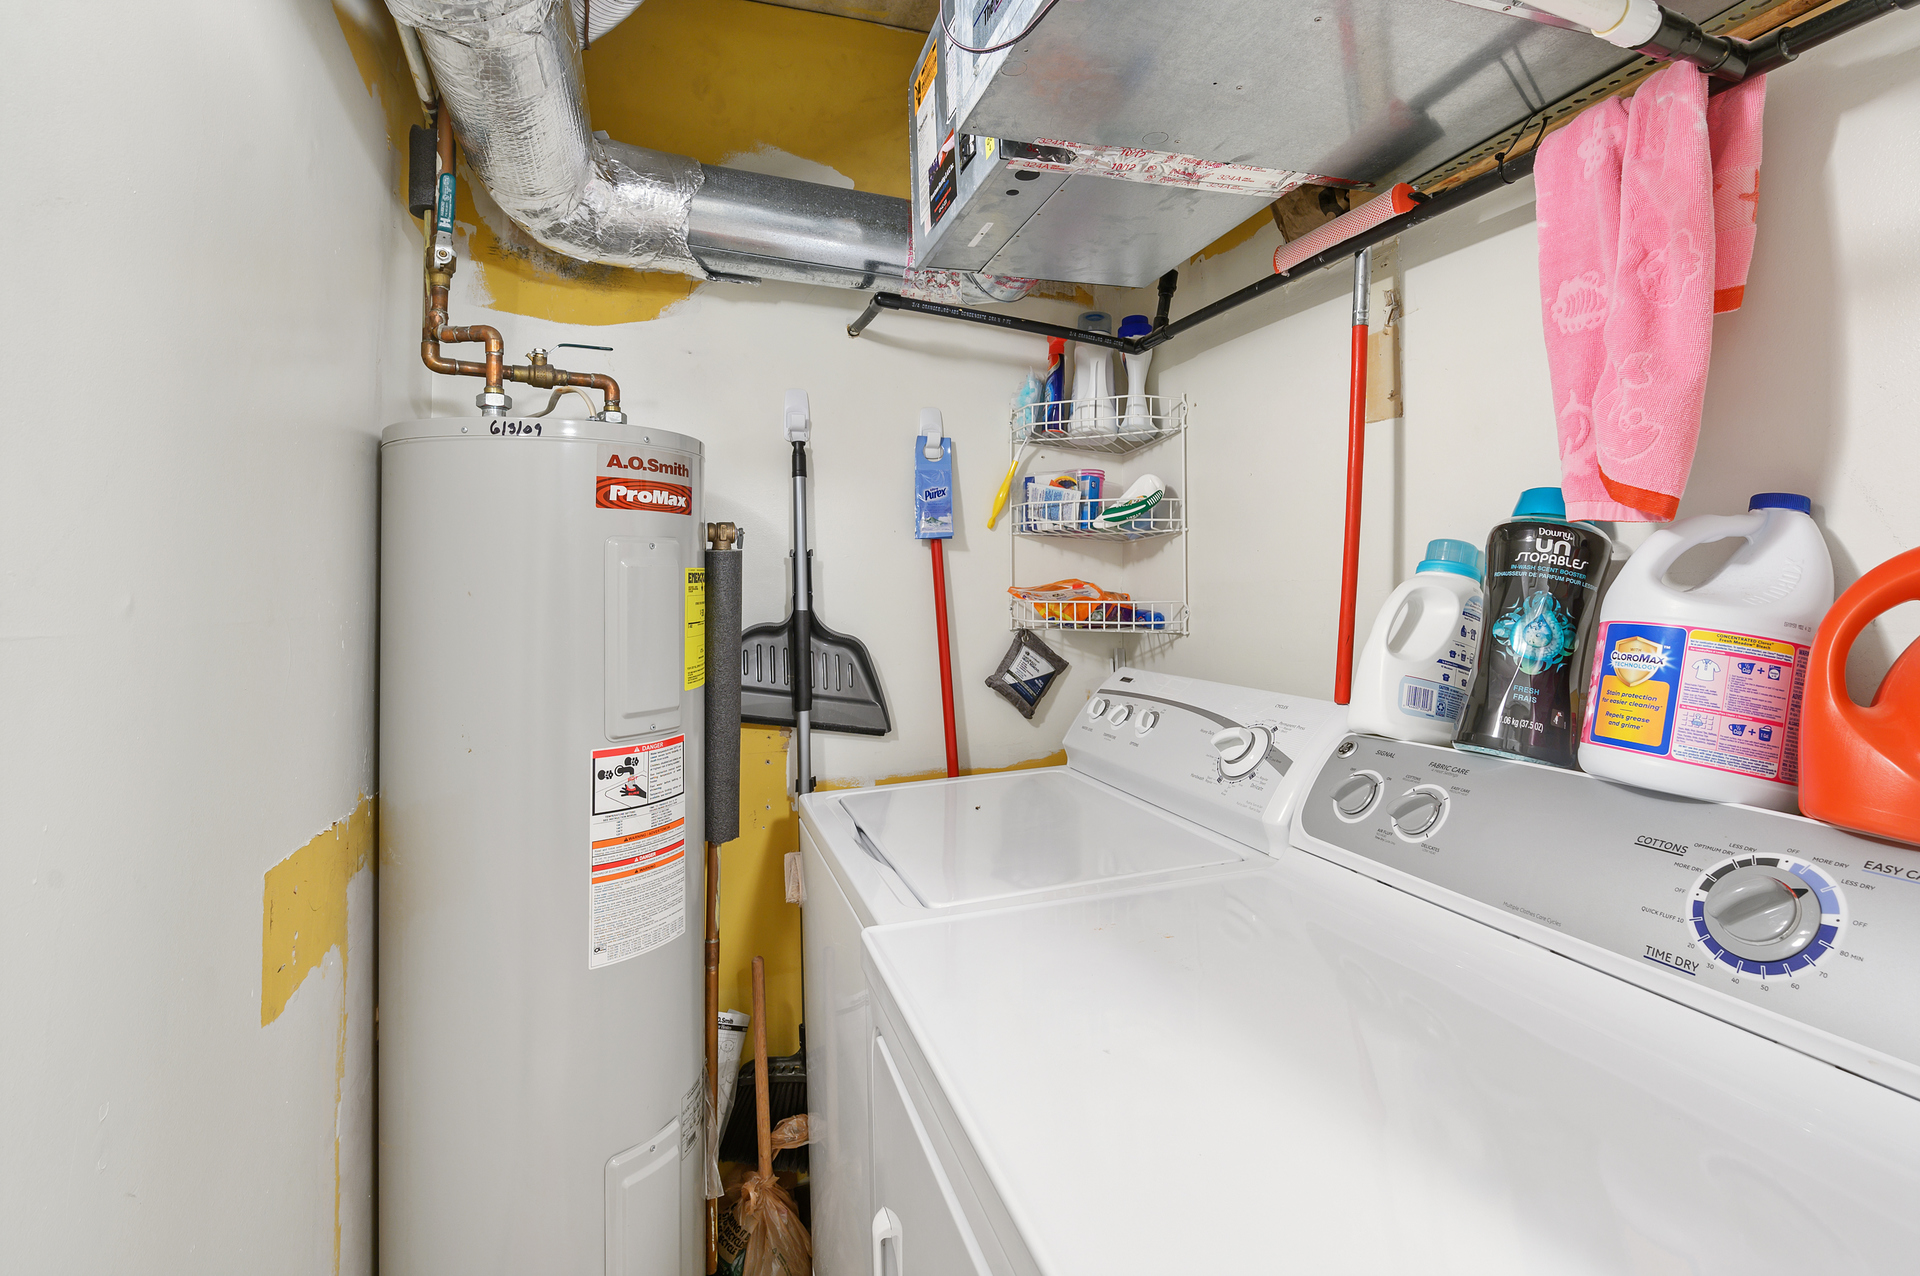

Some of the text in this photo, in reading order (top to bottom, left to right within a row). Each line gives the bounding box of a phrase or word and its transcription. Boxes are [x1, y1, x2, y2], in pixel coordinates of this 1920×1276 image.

[1023, 161, 1050, 171] 324A
[1112, 163, 1137, 171] 10/12
[609, 485, 687, 507] ProMax
[924, 487, 947, 501] Purex
[1538, 527, 1571, 540] Downy
[1515, 551, 1588, 570] STOPABLES
[1539, 573, 1565, 582] PARFUM
[1565, 577, 1582, 586] POUR
[1560, 569, 1587, 580] BOOSTER
[1717, 633, 1757, 643] CONCENTRATED
[1614, 661, 1658, 671] TECHNOLOGY
[1513, 685, 1540, 695] FRESH
[1606, 689, 1658, 702] Stain protection
[1512, 693, 1537, 703] FRAIS
[1609, 698, 1628, 706] easier
[1605, 711, 1650, 723] Repels grease
[1511, 717, 1519, 728] kg
[1519, 719, 1533, 730] (37.5
[642, 741, 664, 752] DANGER
[1375, 750, 1396, 759] SIGNAL
[1428, 761, 1470, 776] FABRIC CARE
[1420, 842, 1440, 853] DELICATES
[1636, 835, 1689, 854] COTTONS
[1693, 842, 1736, 856] OPTIMUM DRY
[1728, 842, 1758, 853] LESS DRY
[639, 852, 657, 861] DANGER
[1786, 847, 1801, 855] OFF
[1673, 861, 1704, 873] MORE DRY
[1812, 856, 1850, 869] MORE DRY
[1863, 860, 1904, 875] EASY
[1674, 886, 1687, 894] OFF
[1840, 878, 1876, 891] LESS DRY
[1503, 901, 1562, 928] Multiple Clothes Care Cycles
[1641, 905, 1659, 915] QUICK
[1659, 911, 1677, 921] FLUFF
[1852, 920, 1868, 929] OFF
[1687, 942, 1696, 950] 20
[1645, 945, 1700, 972] TIME DRY
[1839, 950, 1864, 962] 80 MIN
[1706, 962, 1715, 970] 30
[1818, 970, 1829, 979] 70
[1731, 977, 1740, 985] 40
[1790, 982, 1800, 990] 60
[1760, 984, 1770, 992] 50
